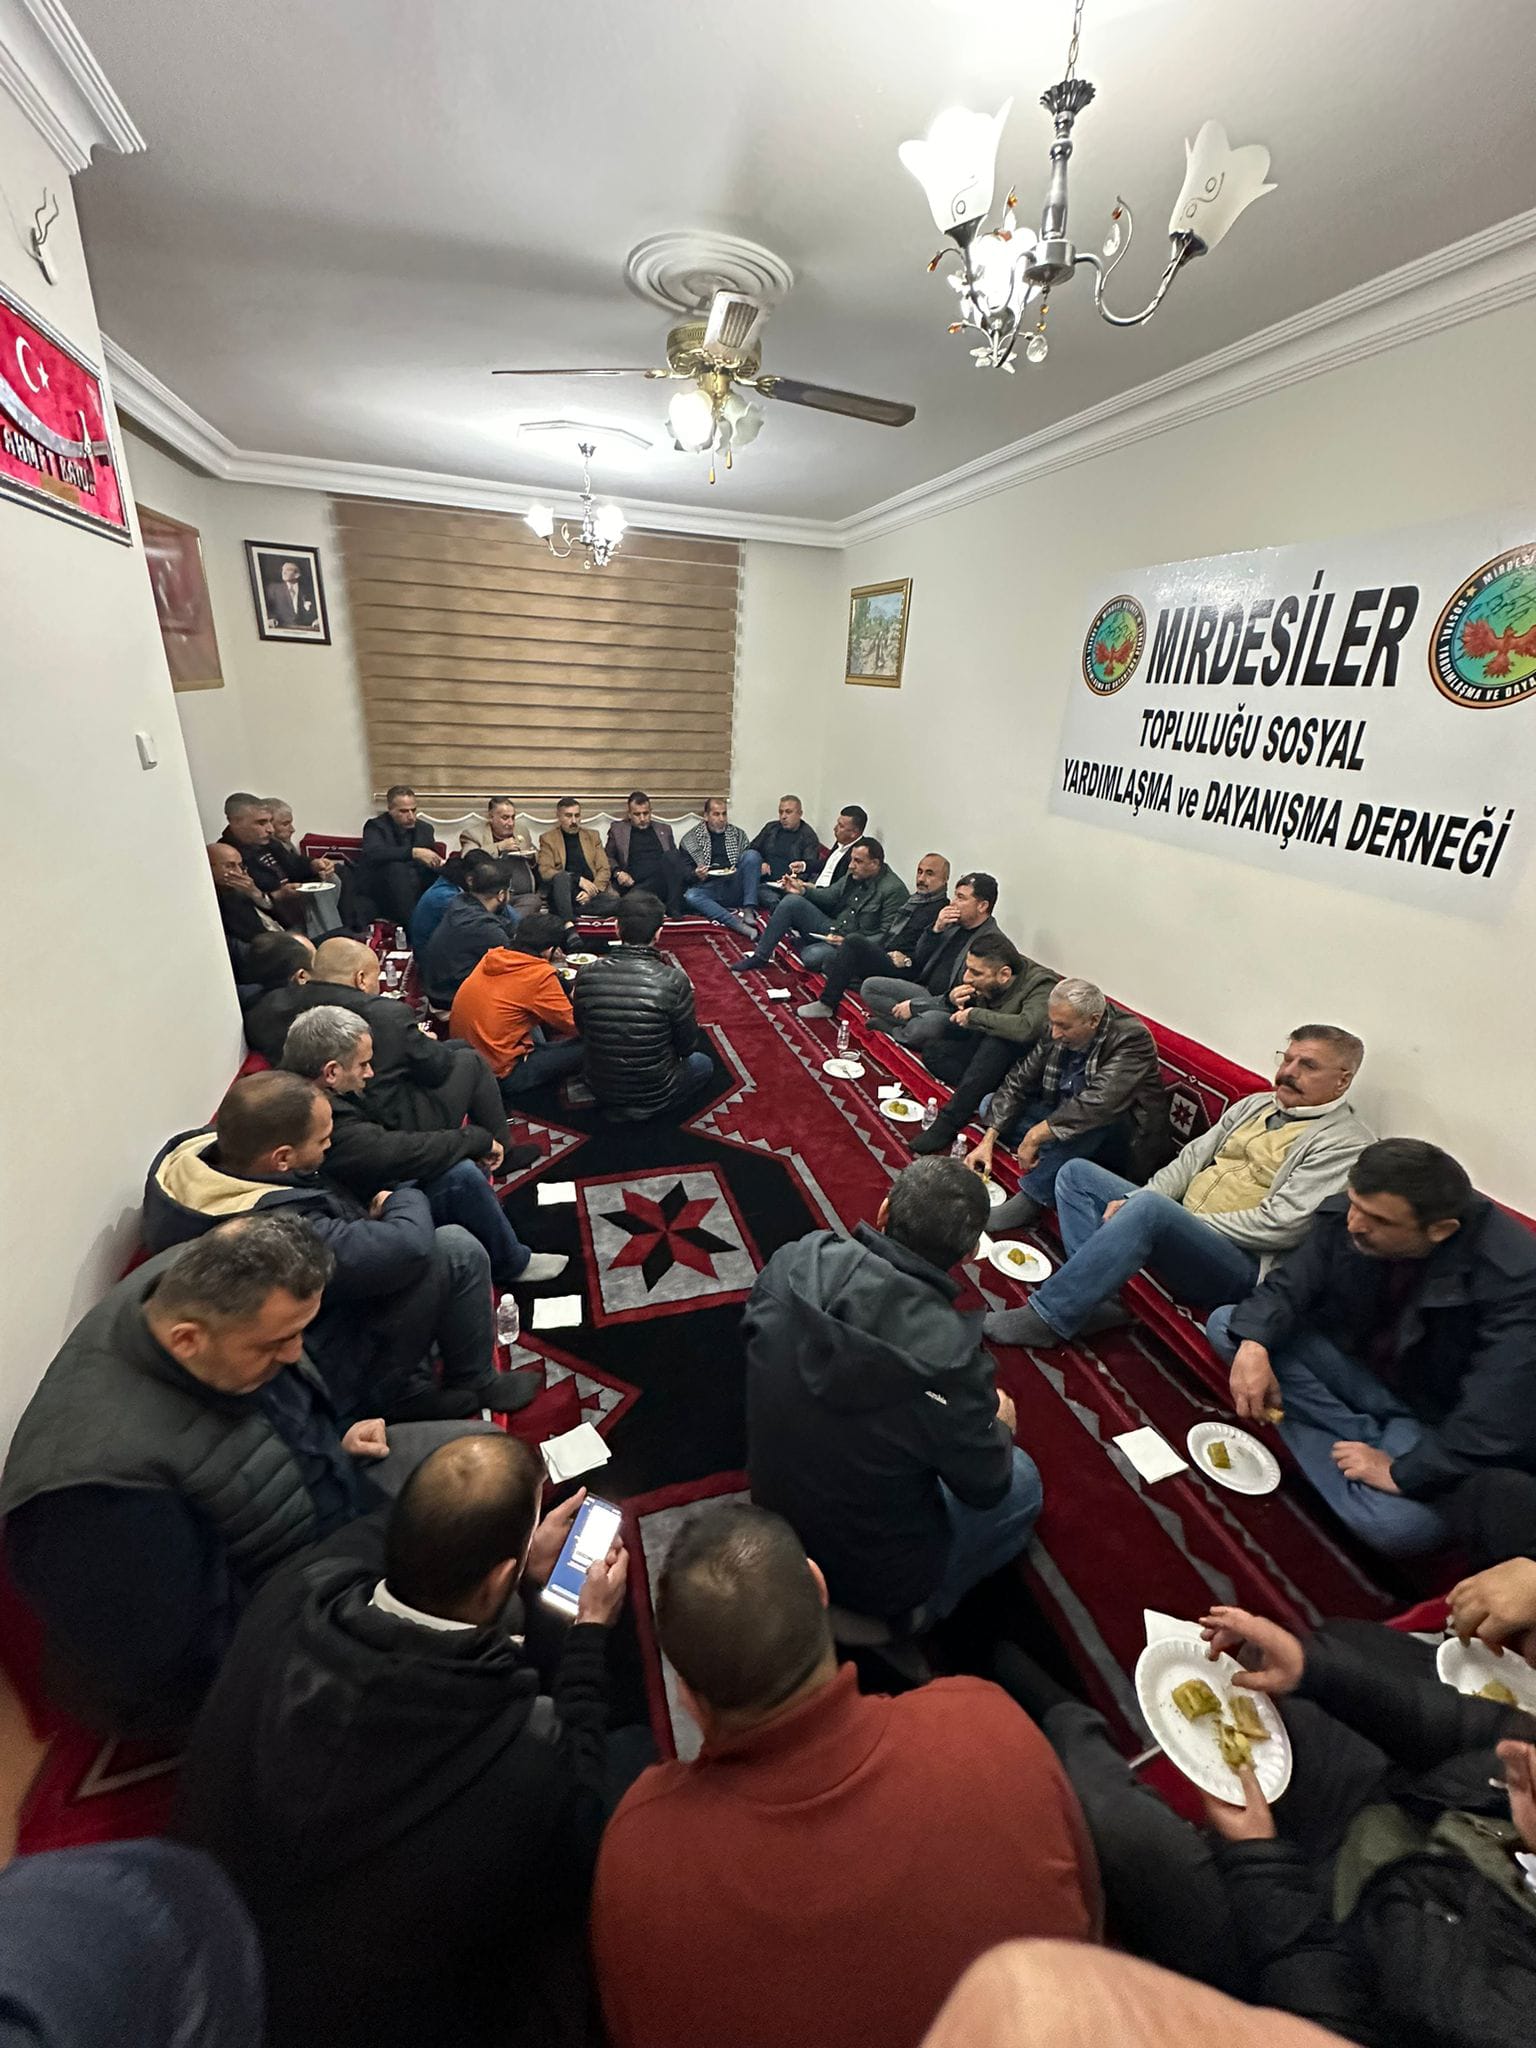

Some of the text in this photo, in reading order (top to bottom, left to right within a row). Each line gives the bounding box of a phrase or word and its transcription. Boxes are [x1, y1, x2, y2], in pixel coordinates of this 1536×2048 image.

[1440, 599, 1467, 642] SOSYAL
[1439, 645, 1482, 699] YARDIMLAŞMA
[1486, 689, 1500, 700] VE
[1140, 703, 1367, 771] TOPLULUĞU SOSYAL
[1063, 758, 1515, 878] YARDIMLAŞMA ve DAYANIŞMA DERNEĞİ
